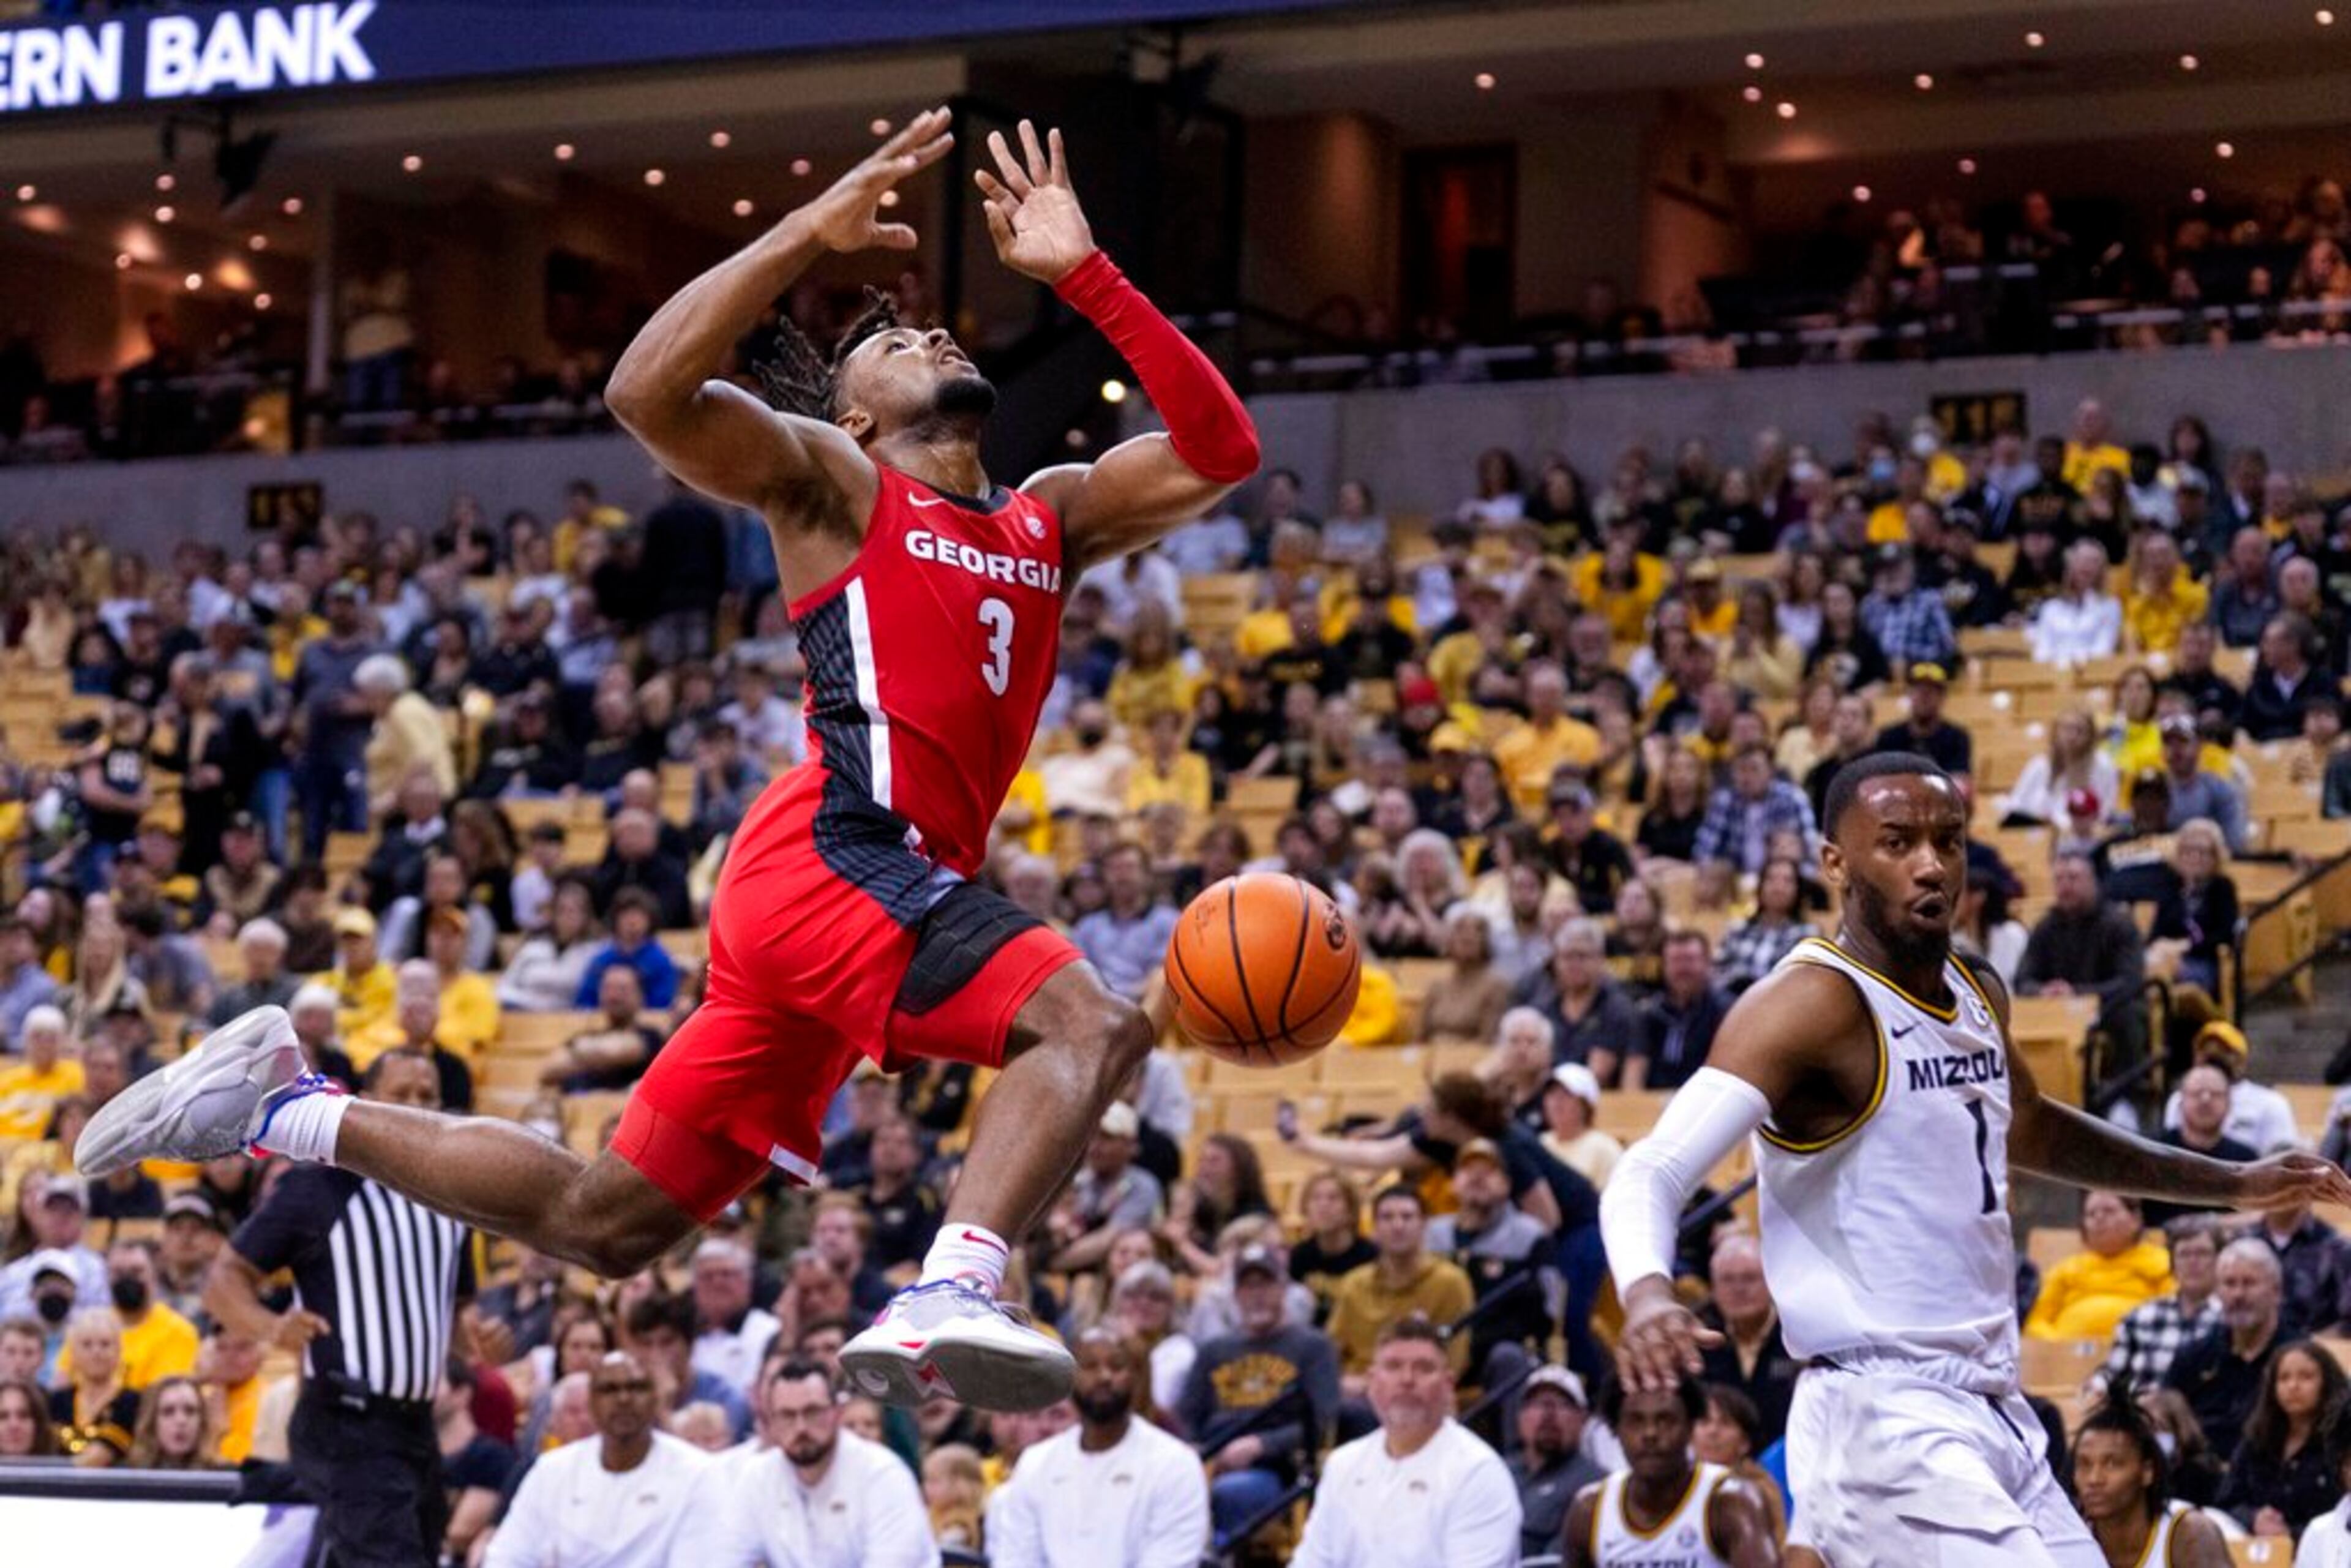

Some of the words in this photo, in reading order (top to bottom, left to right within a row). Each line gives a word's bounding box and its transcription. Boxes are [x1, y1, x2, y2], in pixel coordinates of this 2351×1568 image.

[144, 0, 375, 99] BANK
[905, 530, 1061, 593] GEORGIA
[978, 597, 1014, 696] 3
[1965, 1098, 1997, 1214] 1
